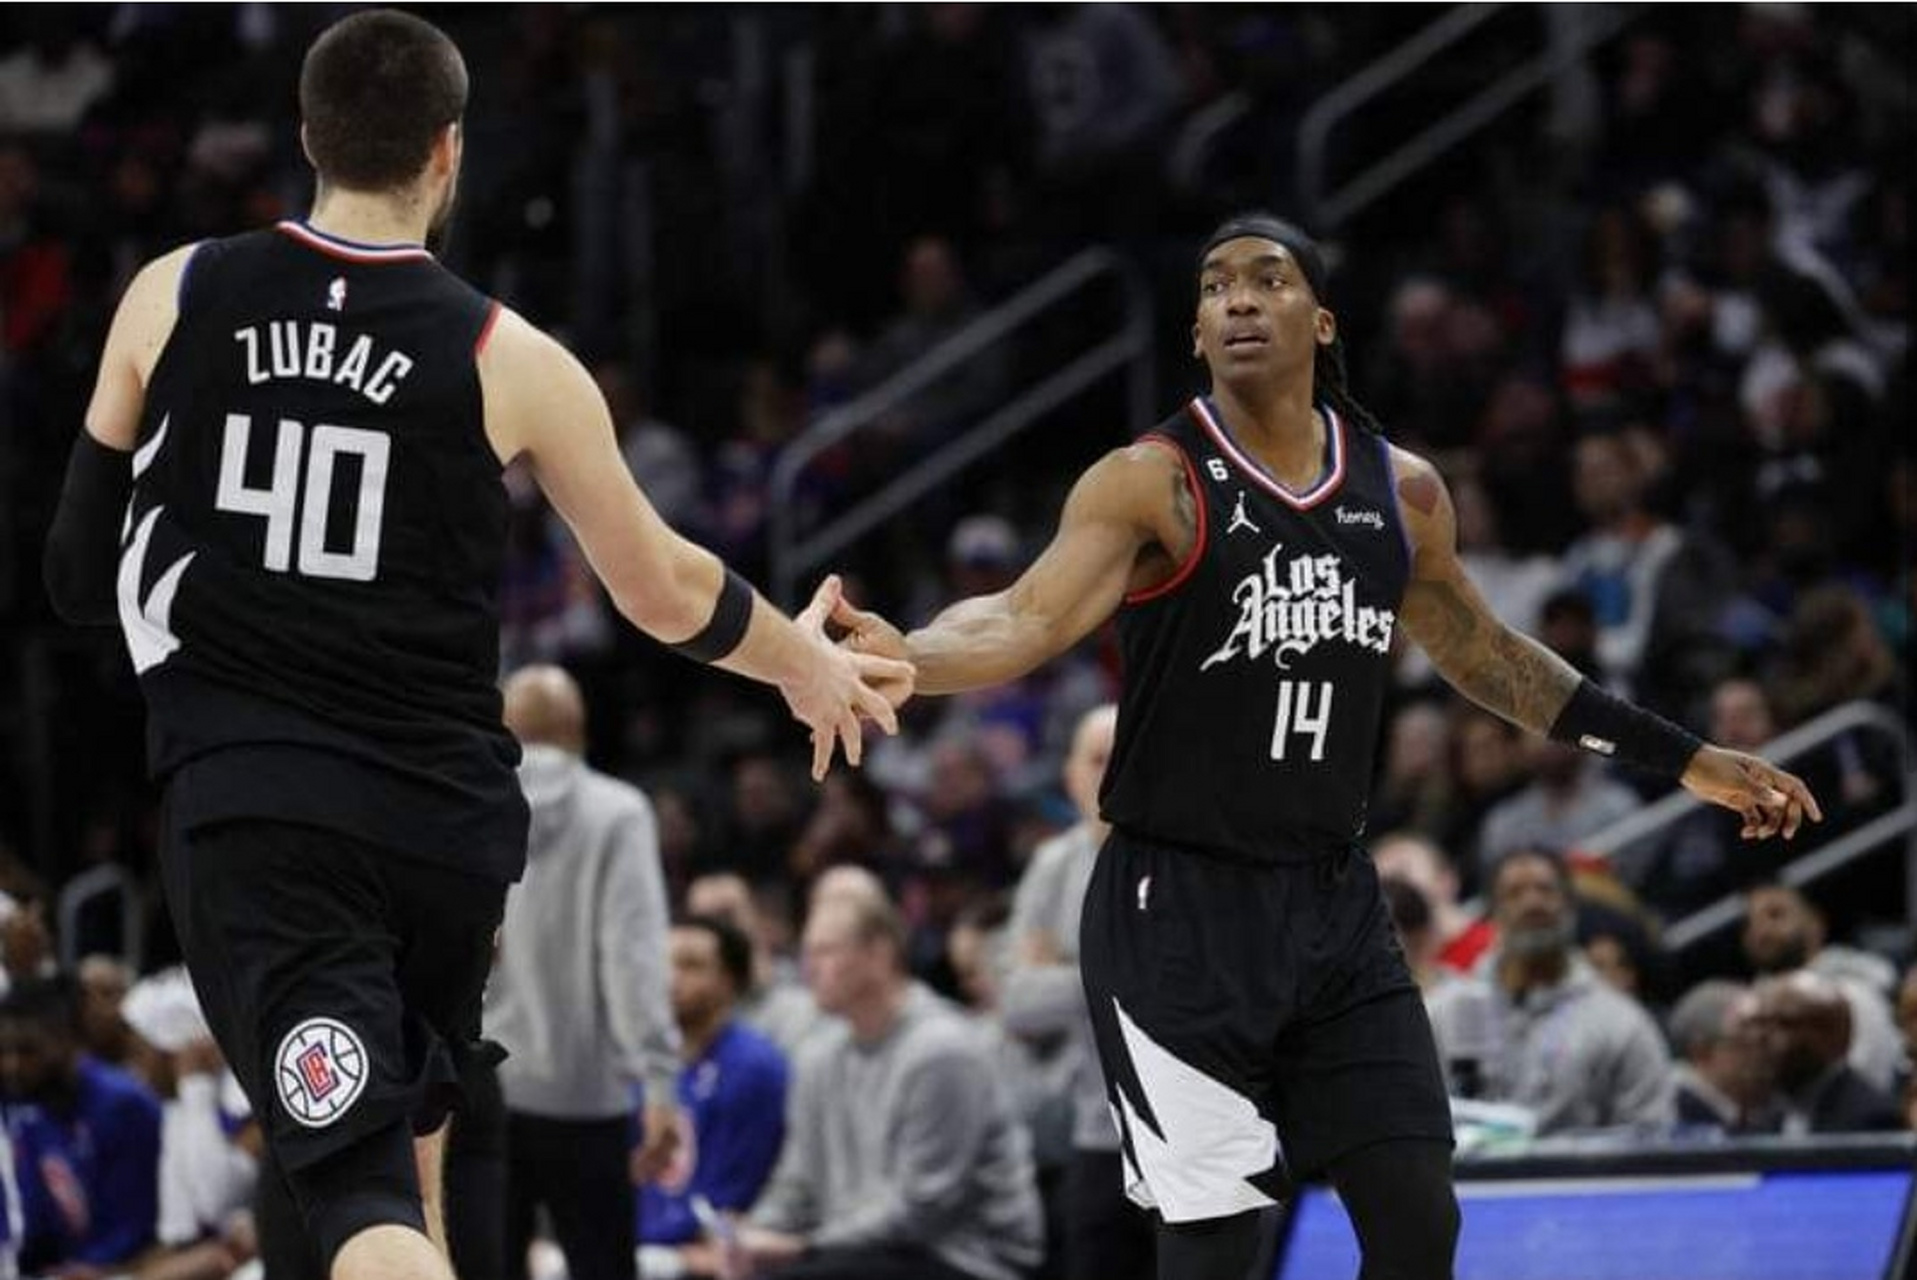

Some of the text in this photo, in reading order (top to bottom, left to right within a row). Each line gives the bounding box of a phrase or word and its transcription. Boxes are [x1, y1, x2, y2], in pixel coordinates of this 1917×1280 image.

[234, 321, 413, 404] ZUBAC
[215, 413, 391, 581] 40
[1206, 458, 1229, 481] 6
[1335, 505, 1385, 530] honey
[1263, 543, 1341, 599] Los
[1200, 576, 1395, 670] Angeles
[1270, 680, 1333, 760] 14
